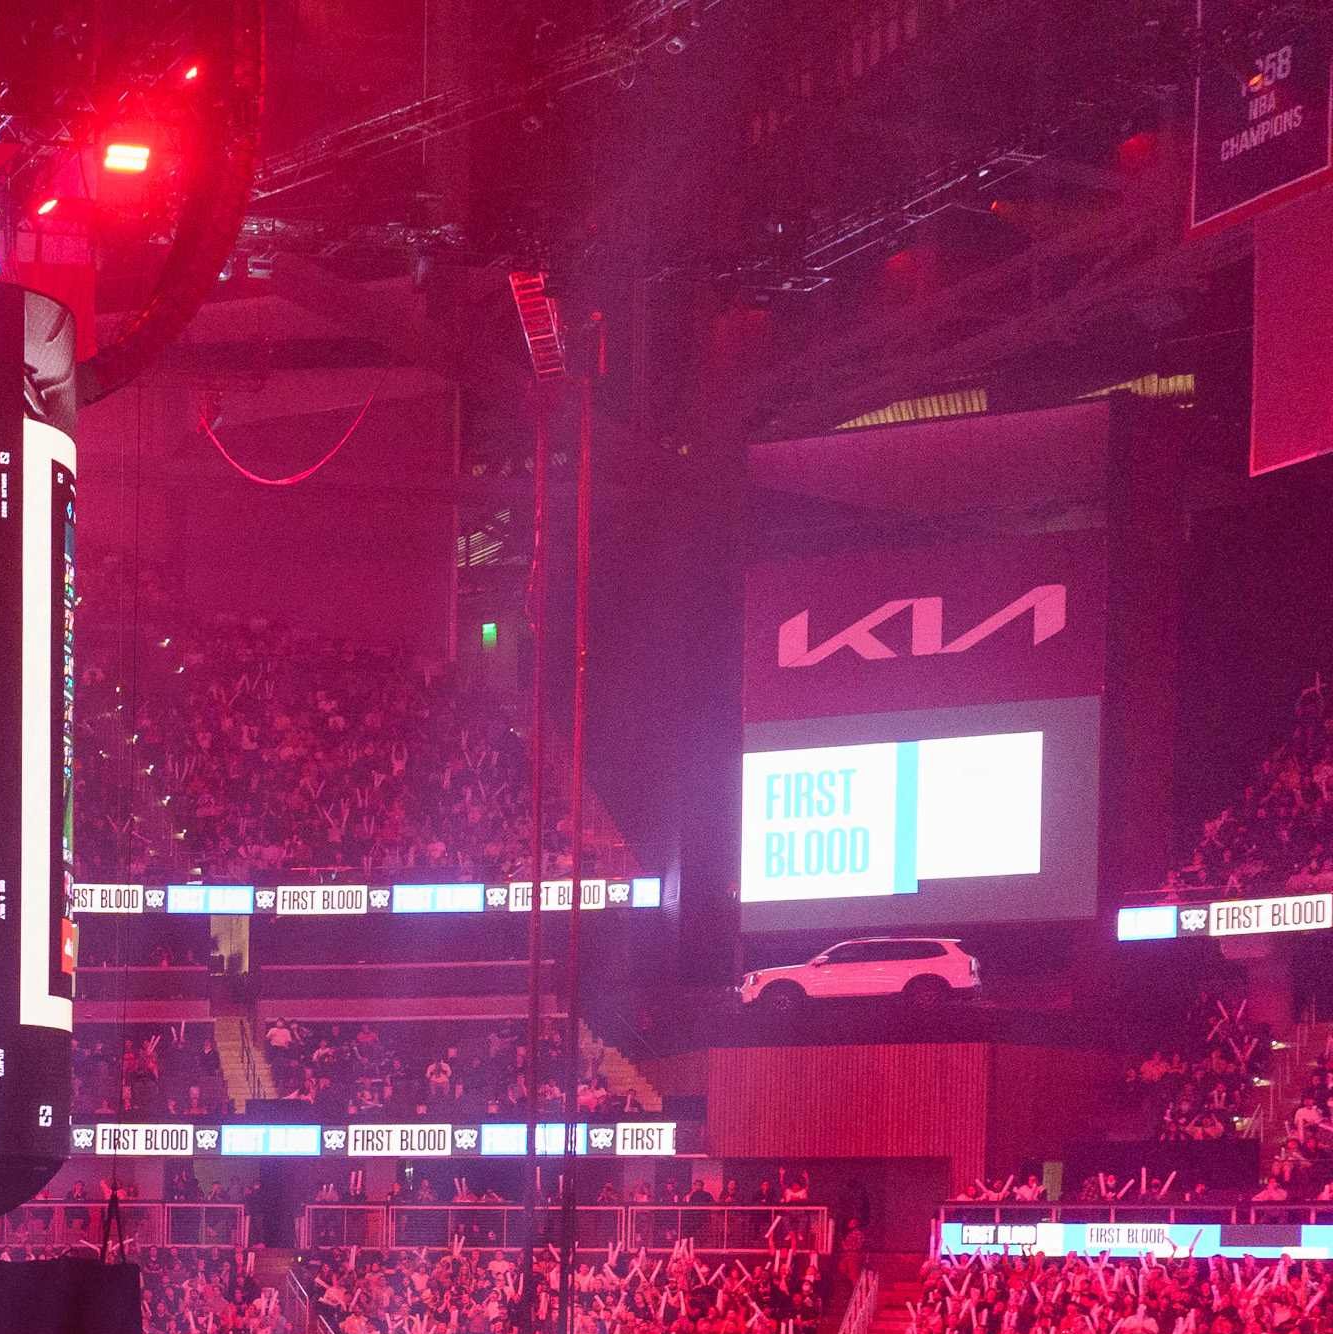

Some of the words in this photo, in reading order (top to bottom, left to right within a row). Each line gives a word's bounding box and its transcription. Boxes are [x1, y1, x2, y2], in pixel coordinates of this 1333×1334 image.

[1220, 104, 1303, 161] CHAMPIONS
[765, 768, 858, 820] FIRST
[764, 827, 870, 879] BLOOD
[100, 888, 139, 910] BLOOD
[281, 889, 317, 911] FIRST
[321, 888, 363, 911] BLOOD
[514, 884, 550, 907] FIRT
[558, 882, 601, 907] BLOD
[1215, 903, 1263, 931] FIRST
[1270, 899, 1327, 928] BLOOD
[101, 1128, 138, 1152] FIRST
[144, 1128, 188, 1151] BLOOD
[353, 1128, 395, 1152] FIRST
[400, 1128, 446, 1152] BLOOD
[621, 1126, 665, 1151] FIRST
[1089, 1228, 1121, 1244] FIRST
